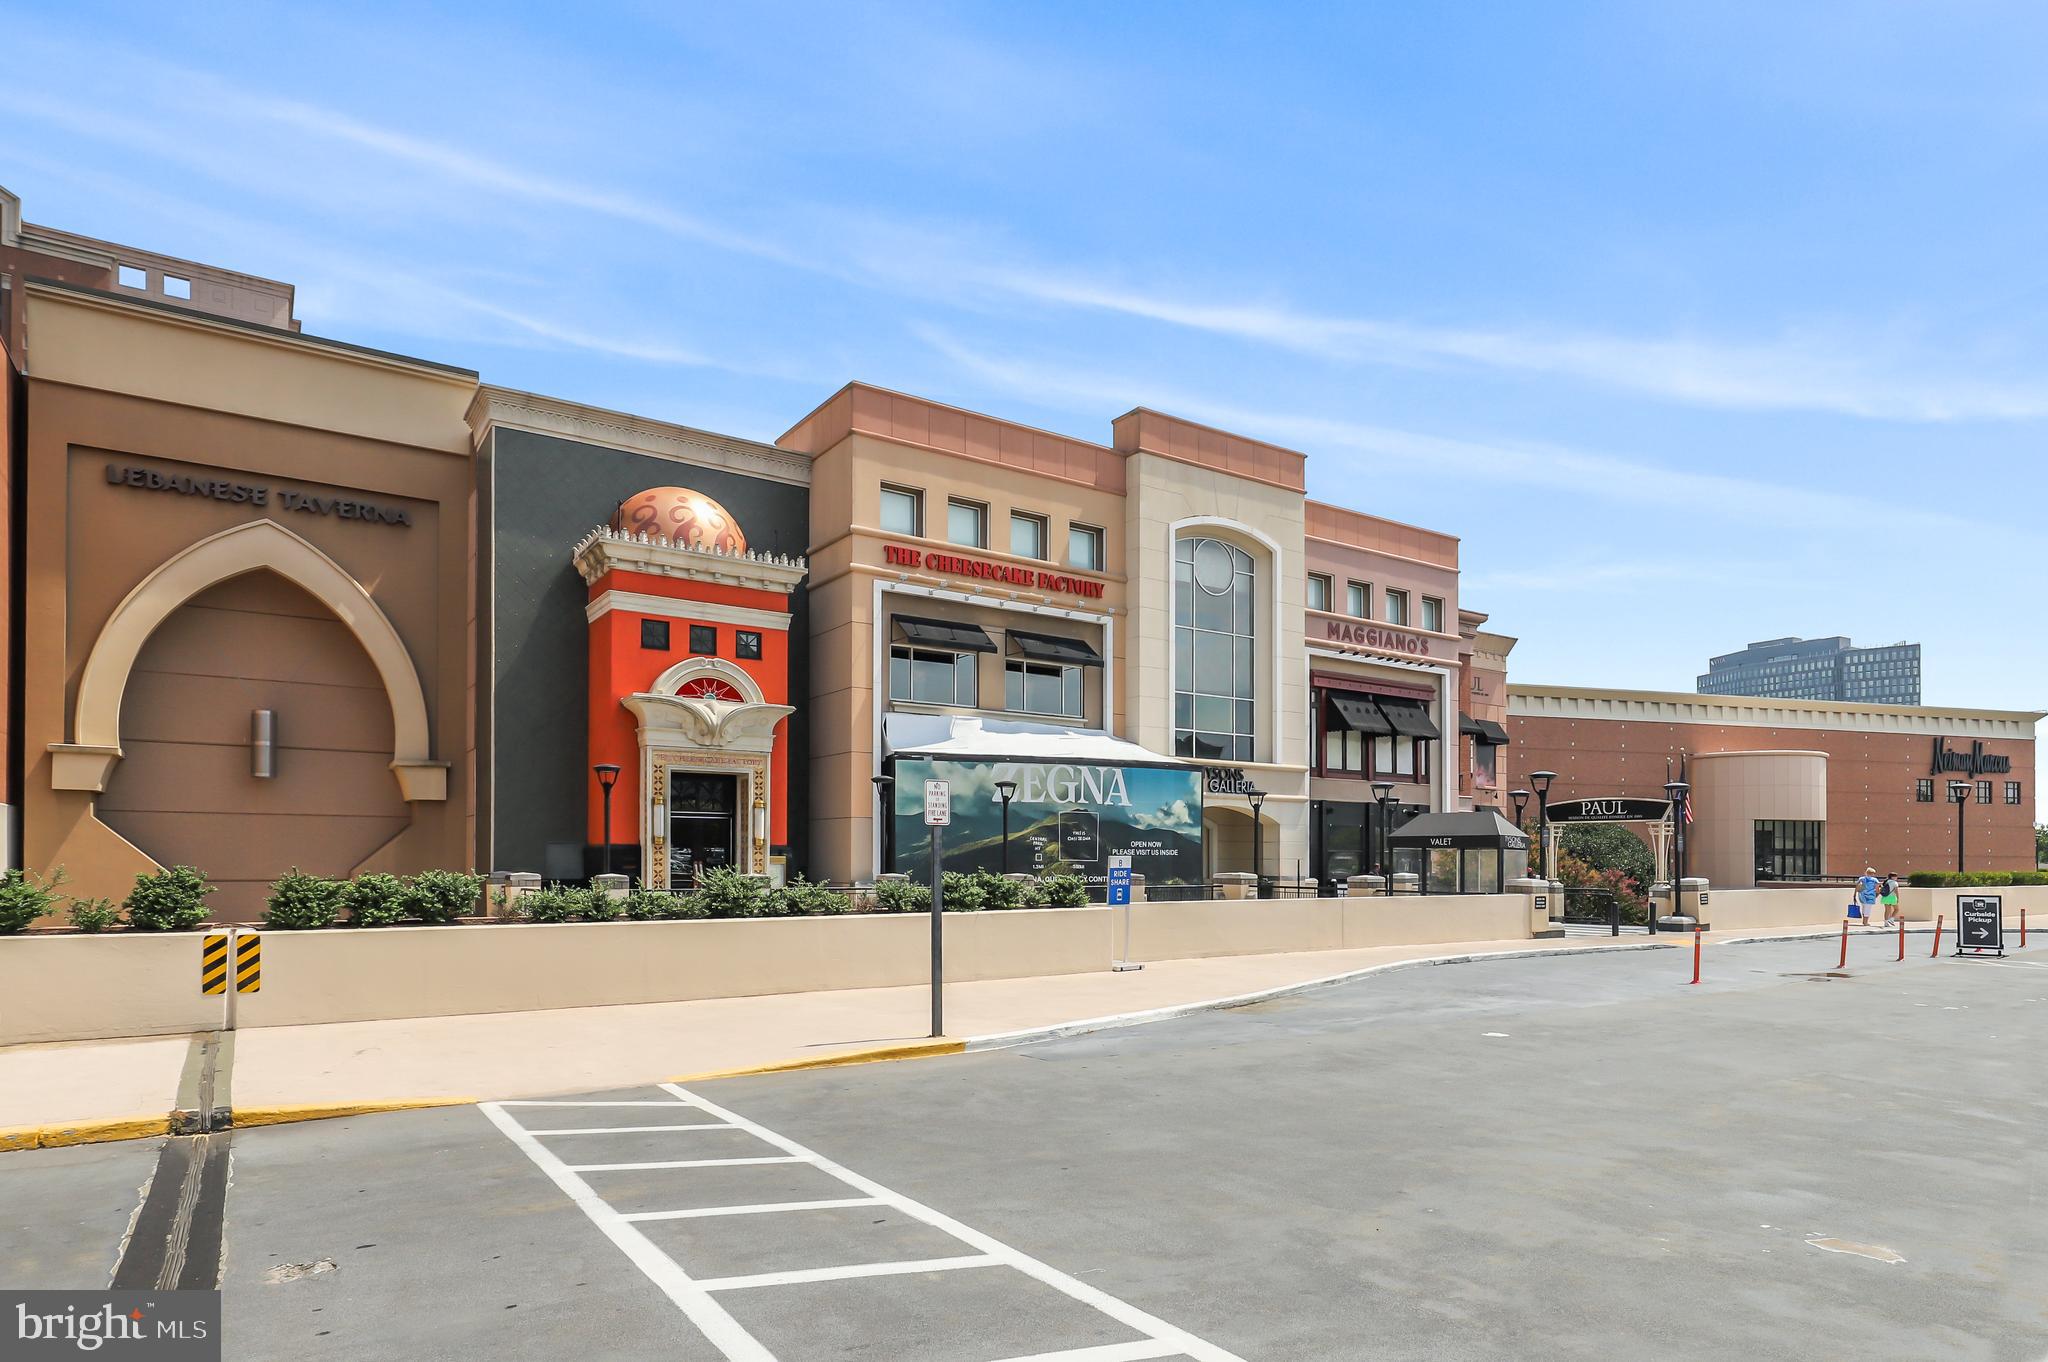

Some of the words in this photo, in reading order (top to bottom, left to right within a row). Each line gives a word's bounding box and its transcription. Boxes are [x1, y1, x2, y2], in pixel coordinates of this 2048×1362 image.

[105, 463, 268, 506] LEBANESE
[278, 490, 411, 527] TAVERNA
[883, 545, 921, 567] THE
[925, 552, 1035, 586] CHEESECAKE
[1037, 572, 1106, 598] FACTORY
[1326, 621, 1429, 655] MAGGIANO'S
[1930, 736, 1973, 779] Neiman
[1972, 739, 2012, 774] Marcus
[991, 762, 1132, 807] ZEGNA
[1209, 779, 1255, 793] GALLERIA
[1581, 801, 1628, 815] PAUL
[1135, 848, 1150, 856] VISIT
[1430, 838, 1452, 846] VALET
